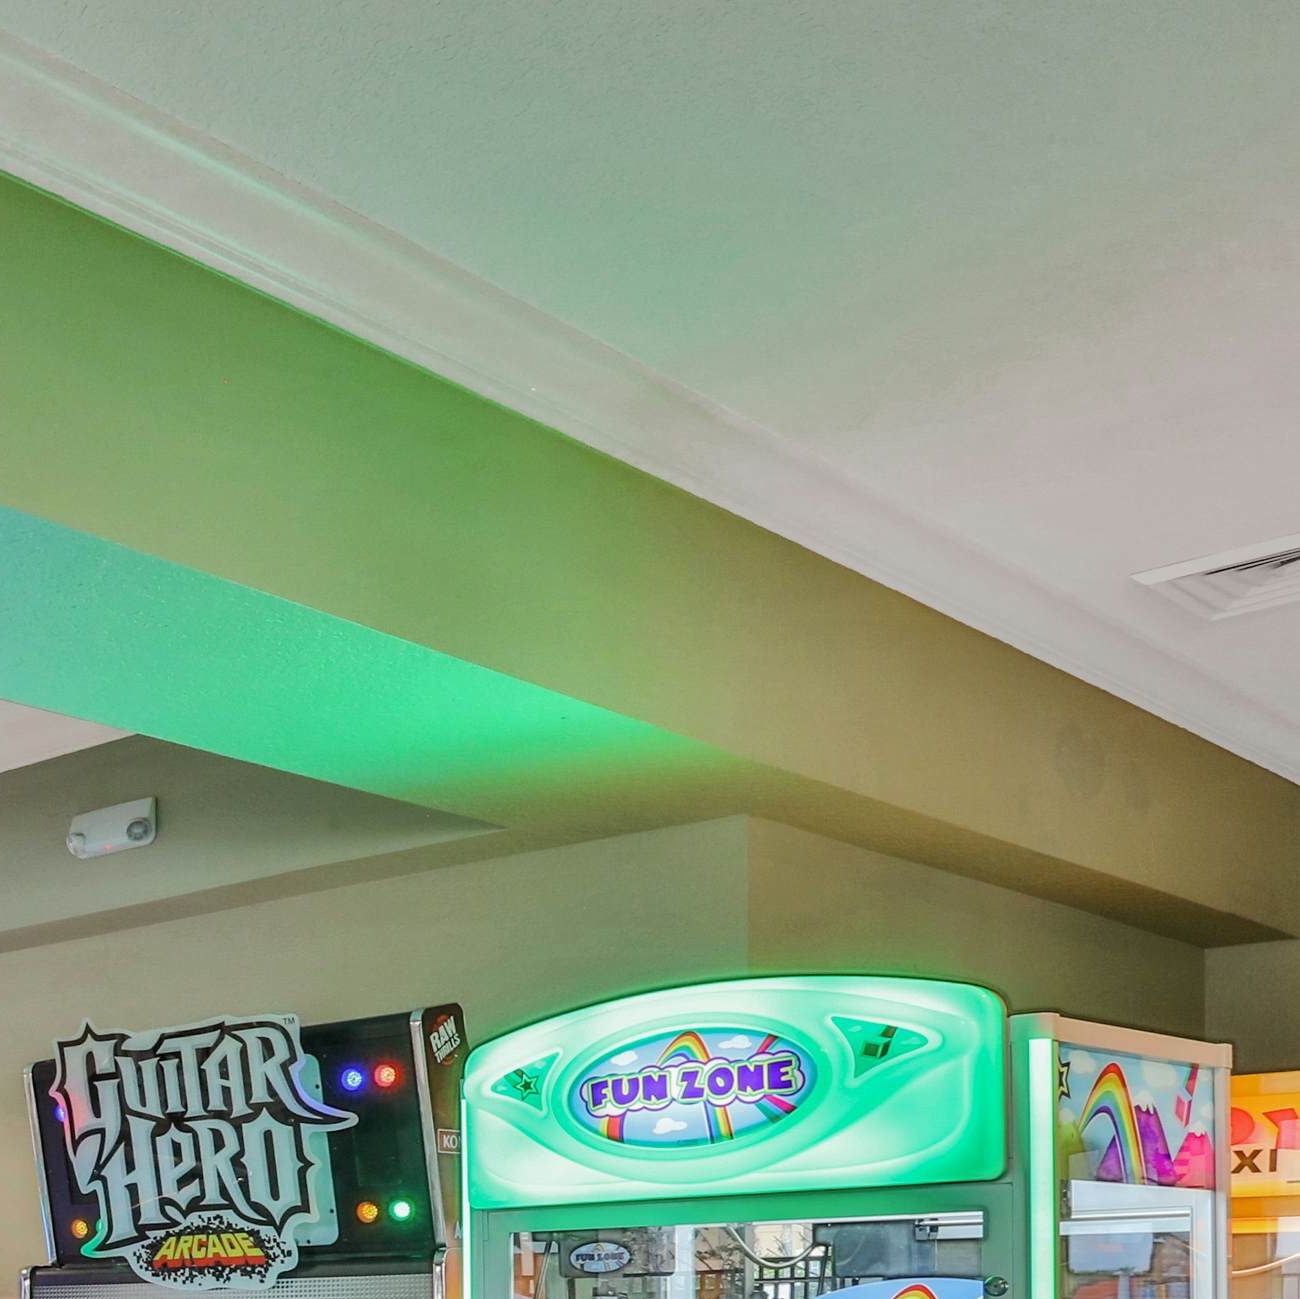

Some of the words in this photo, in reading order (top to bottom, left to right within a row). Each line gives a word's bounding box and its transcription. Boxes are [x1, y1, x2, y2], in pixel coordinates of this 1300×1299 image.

[430, 1016, 456, 1052] RAW
[435, 1033, 460, 1063] THRILLS
[590, 1074, 668, 1108] FUN
[680, 1059, 794, 1100] ZONE
[1231, 1149, 1278, 1174] XI
[152, 1232, 267, 1269] ARCADE
